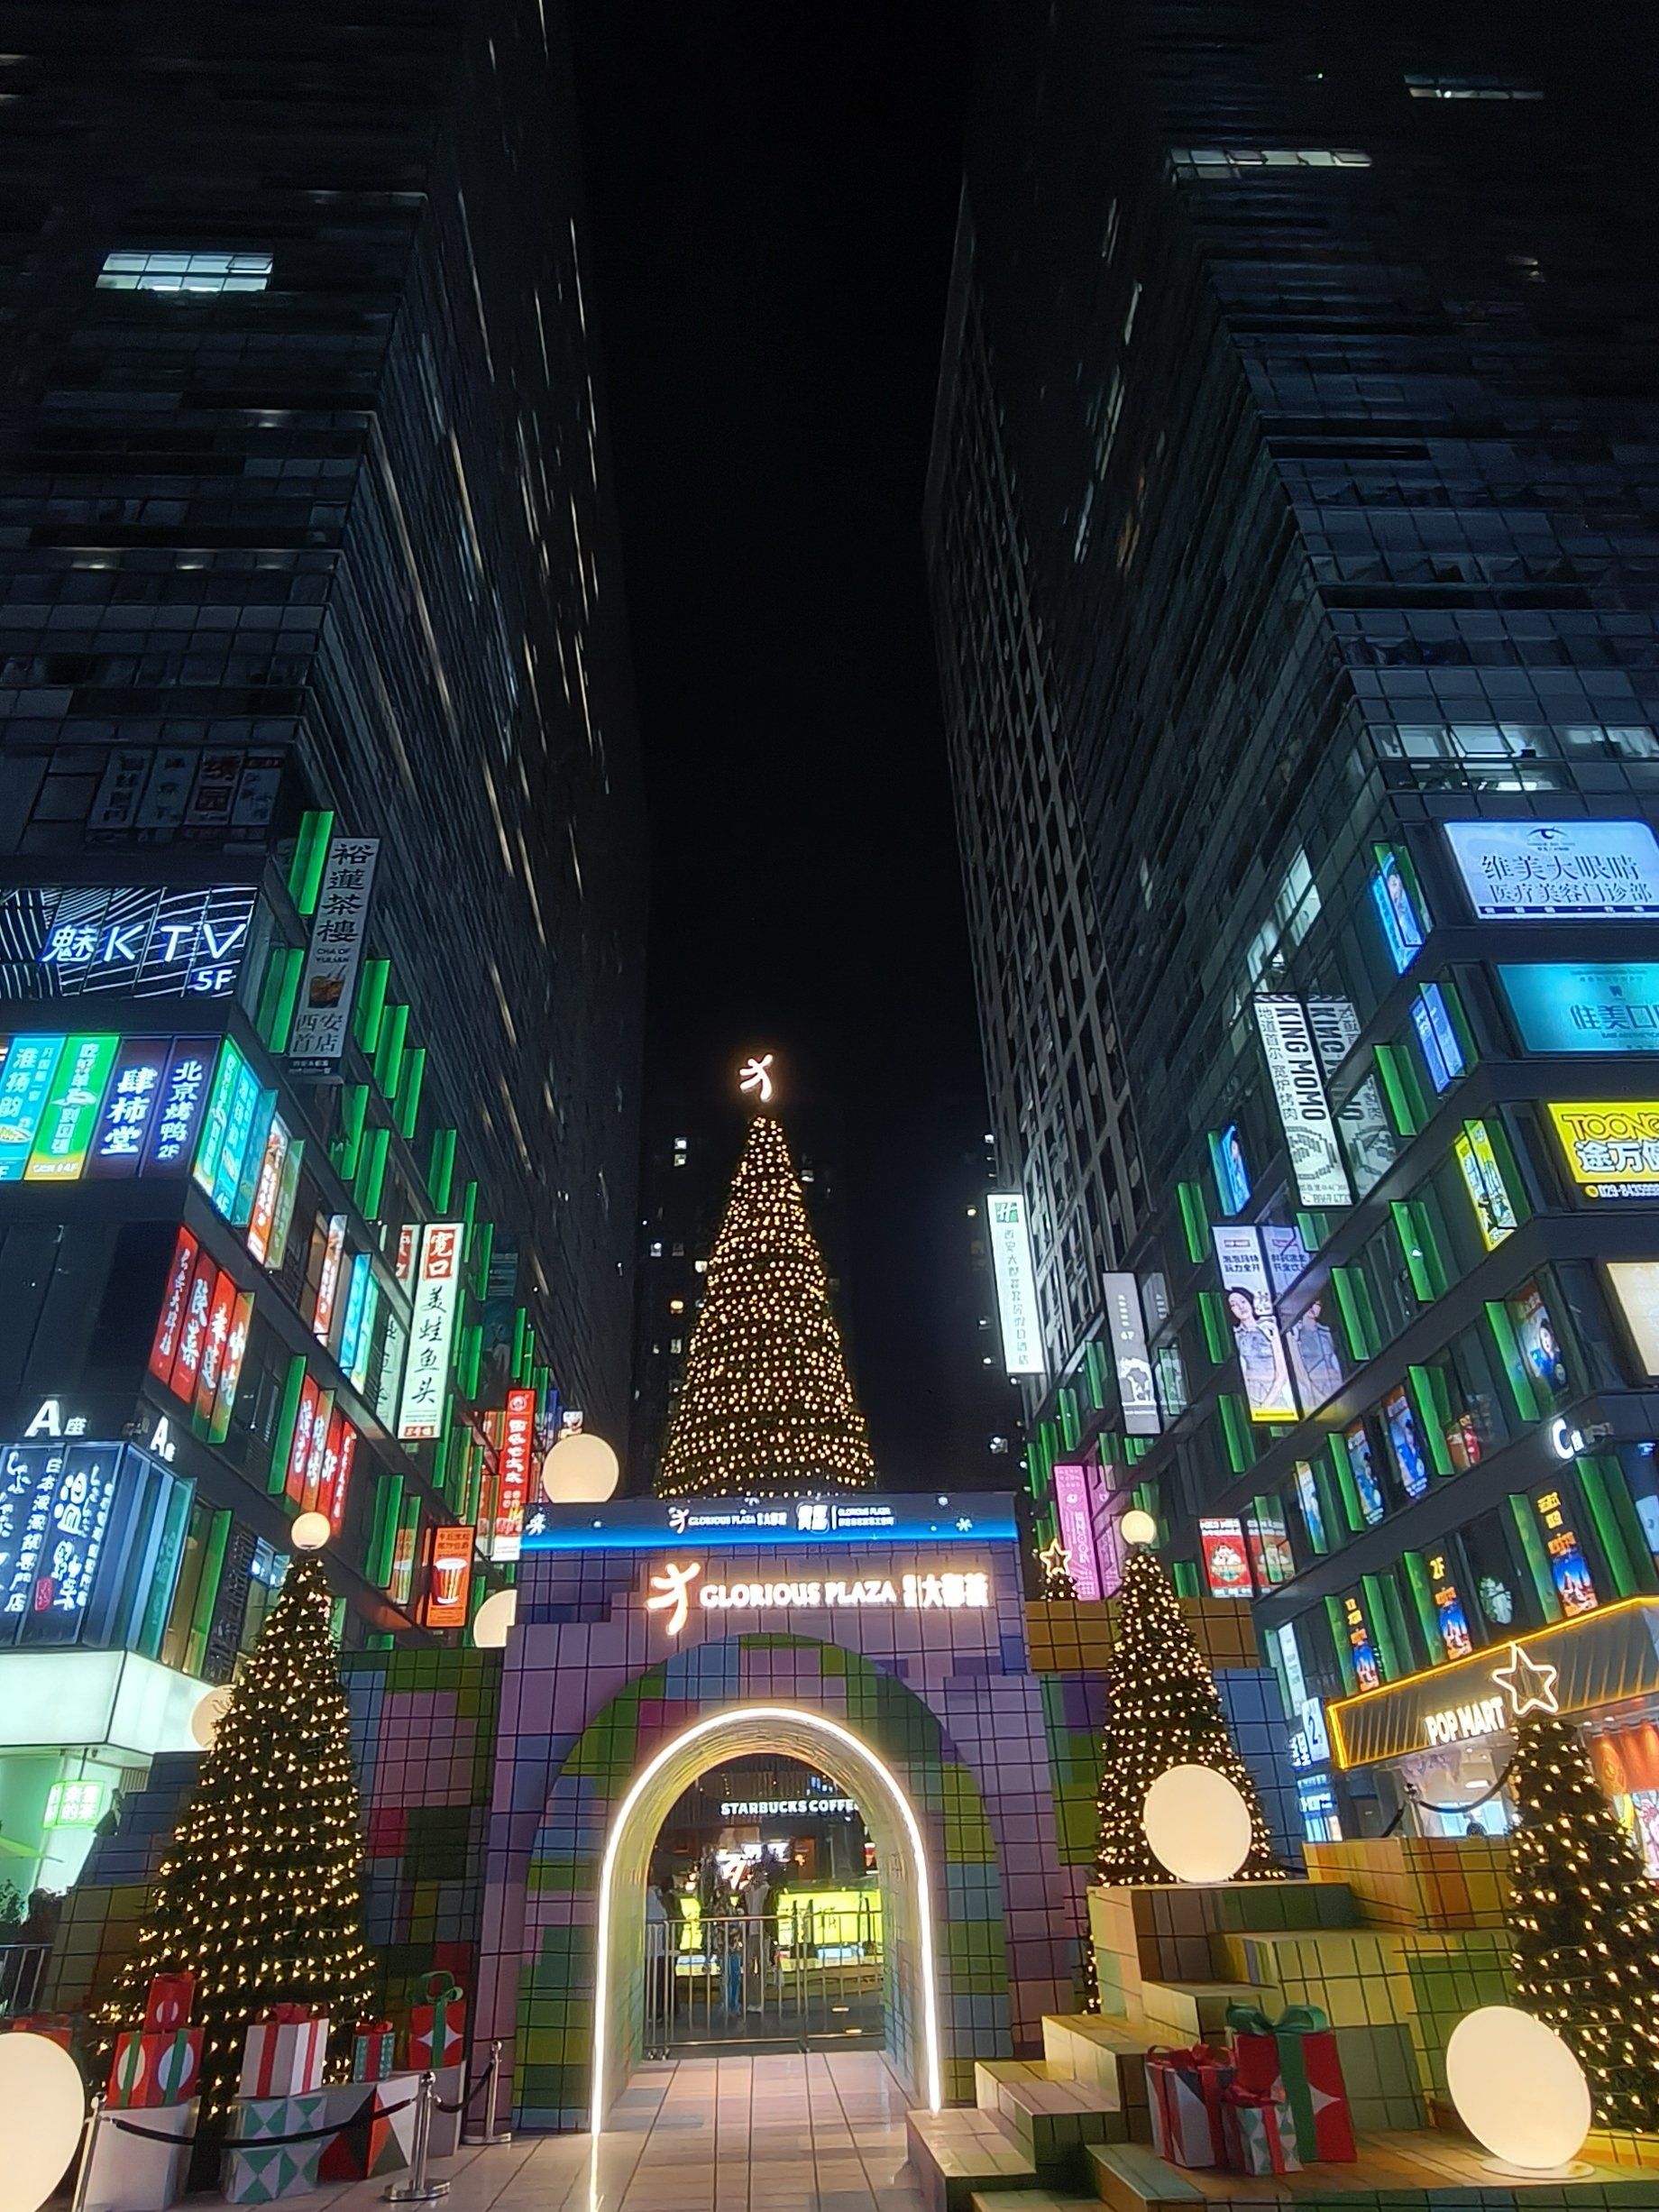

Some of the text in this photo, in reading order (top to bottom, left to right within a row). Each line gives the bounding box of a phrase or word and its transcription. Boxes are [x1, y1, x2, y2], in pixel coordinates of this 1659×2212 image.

[1482, 856, 1638, 881] 维美大眼睛
[316, 844, 374, 943] 裕蓮茶樓
[1489, 883, 1653, 903] 医疗美容门诊部
[194, 969, 234, 991] 5F
[1275, 1007, 1326, 1120] KING MOMO
[160, 1060, 203, 1142] 北京烤鸭
[158, 1143, 179, 1159] 2F
[412, 1286, 447, 1405] 美蛙鱼头
[700, 1583, 820, 1609] GLORIOUS
[825, 1581, 897, 1605] PLAZA
[1425, 1695, 1506, 1746] POP MART
[720, 1800, 808, 1815] STARBUCKS
